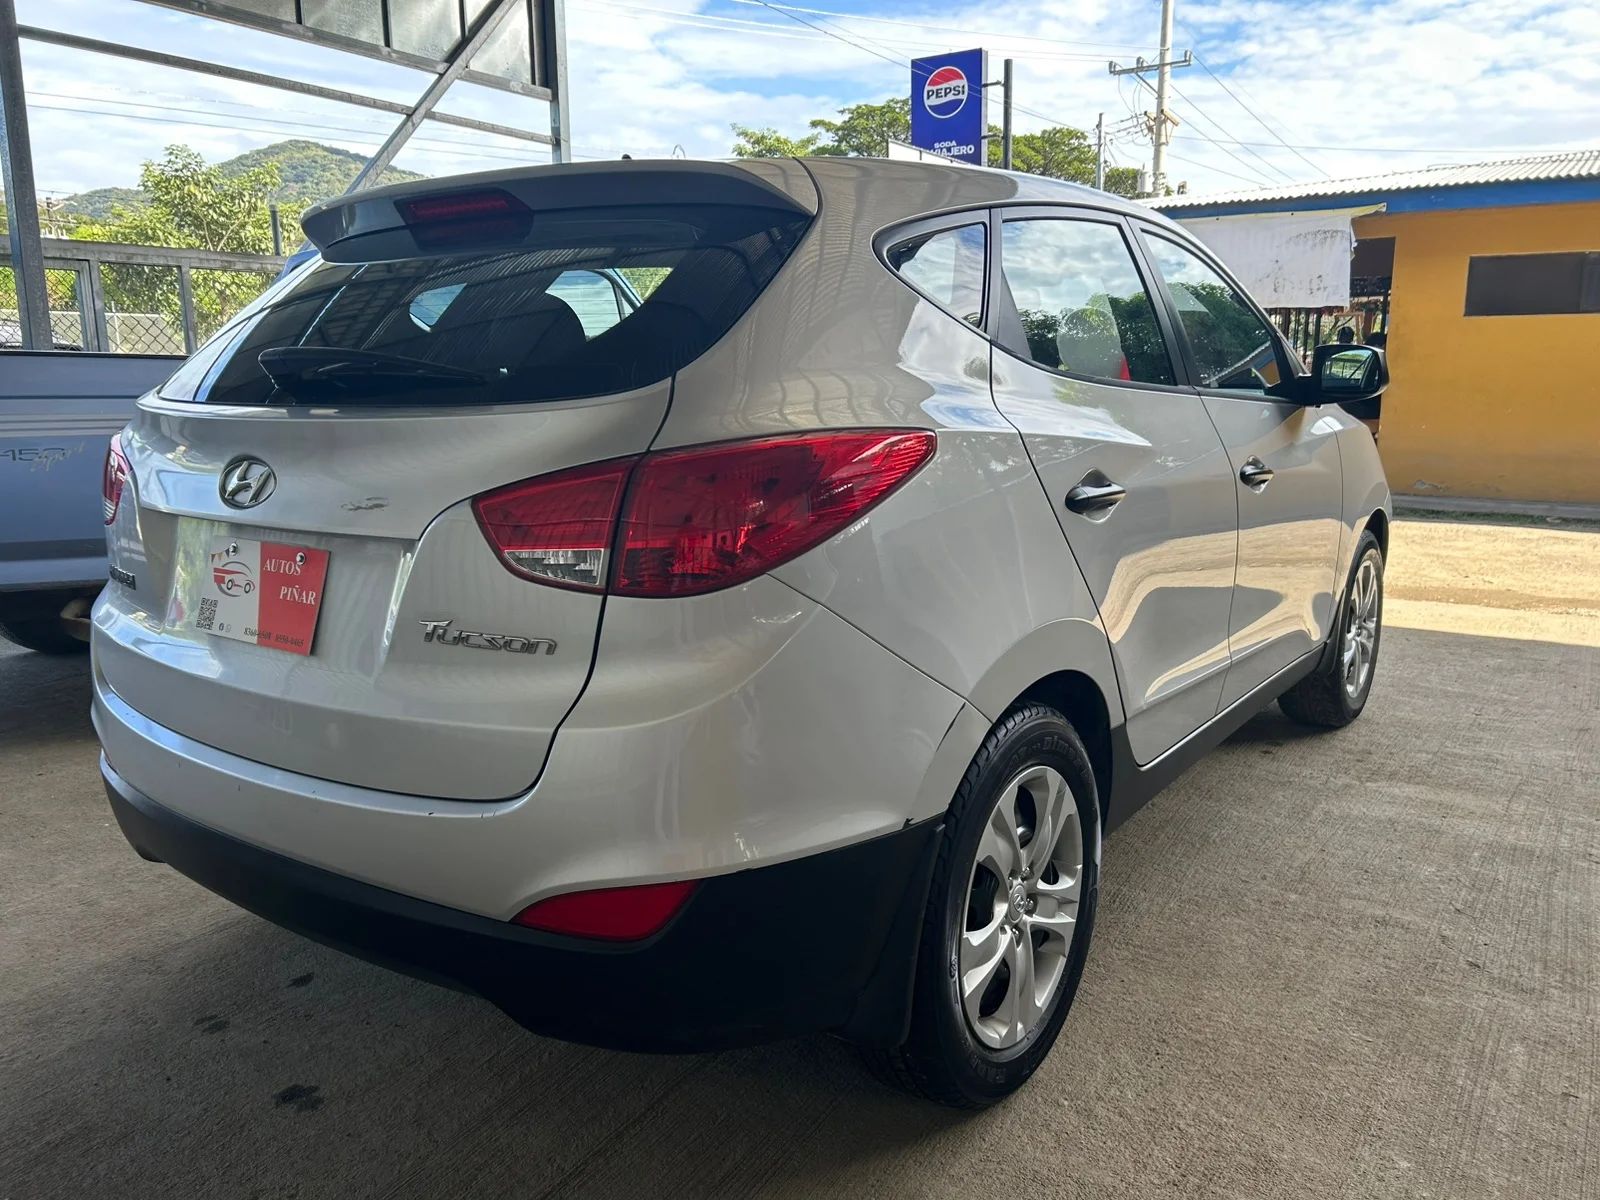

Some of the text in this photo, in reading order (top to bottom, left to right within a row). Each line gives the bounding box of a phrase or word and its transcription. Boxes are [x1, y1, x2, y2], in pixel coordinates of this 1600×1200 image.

[926, 84, 965, 100] PEPSI
[933, 140, 957, 149] SODA
[263, 558, 301, 576] AUTOS
[279, 584, 317, 605] PIÑAR
